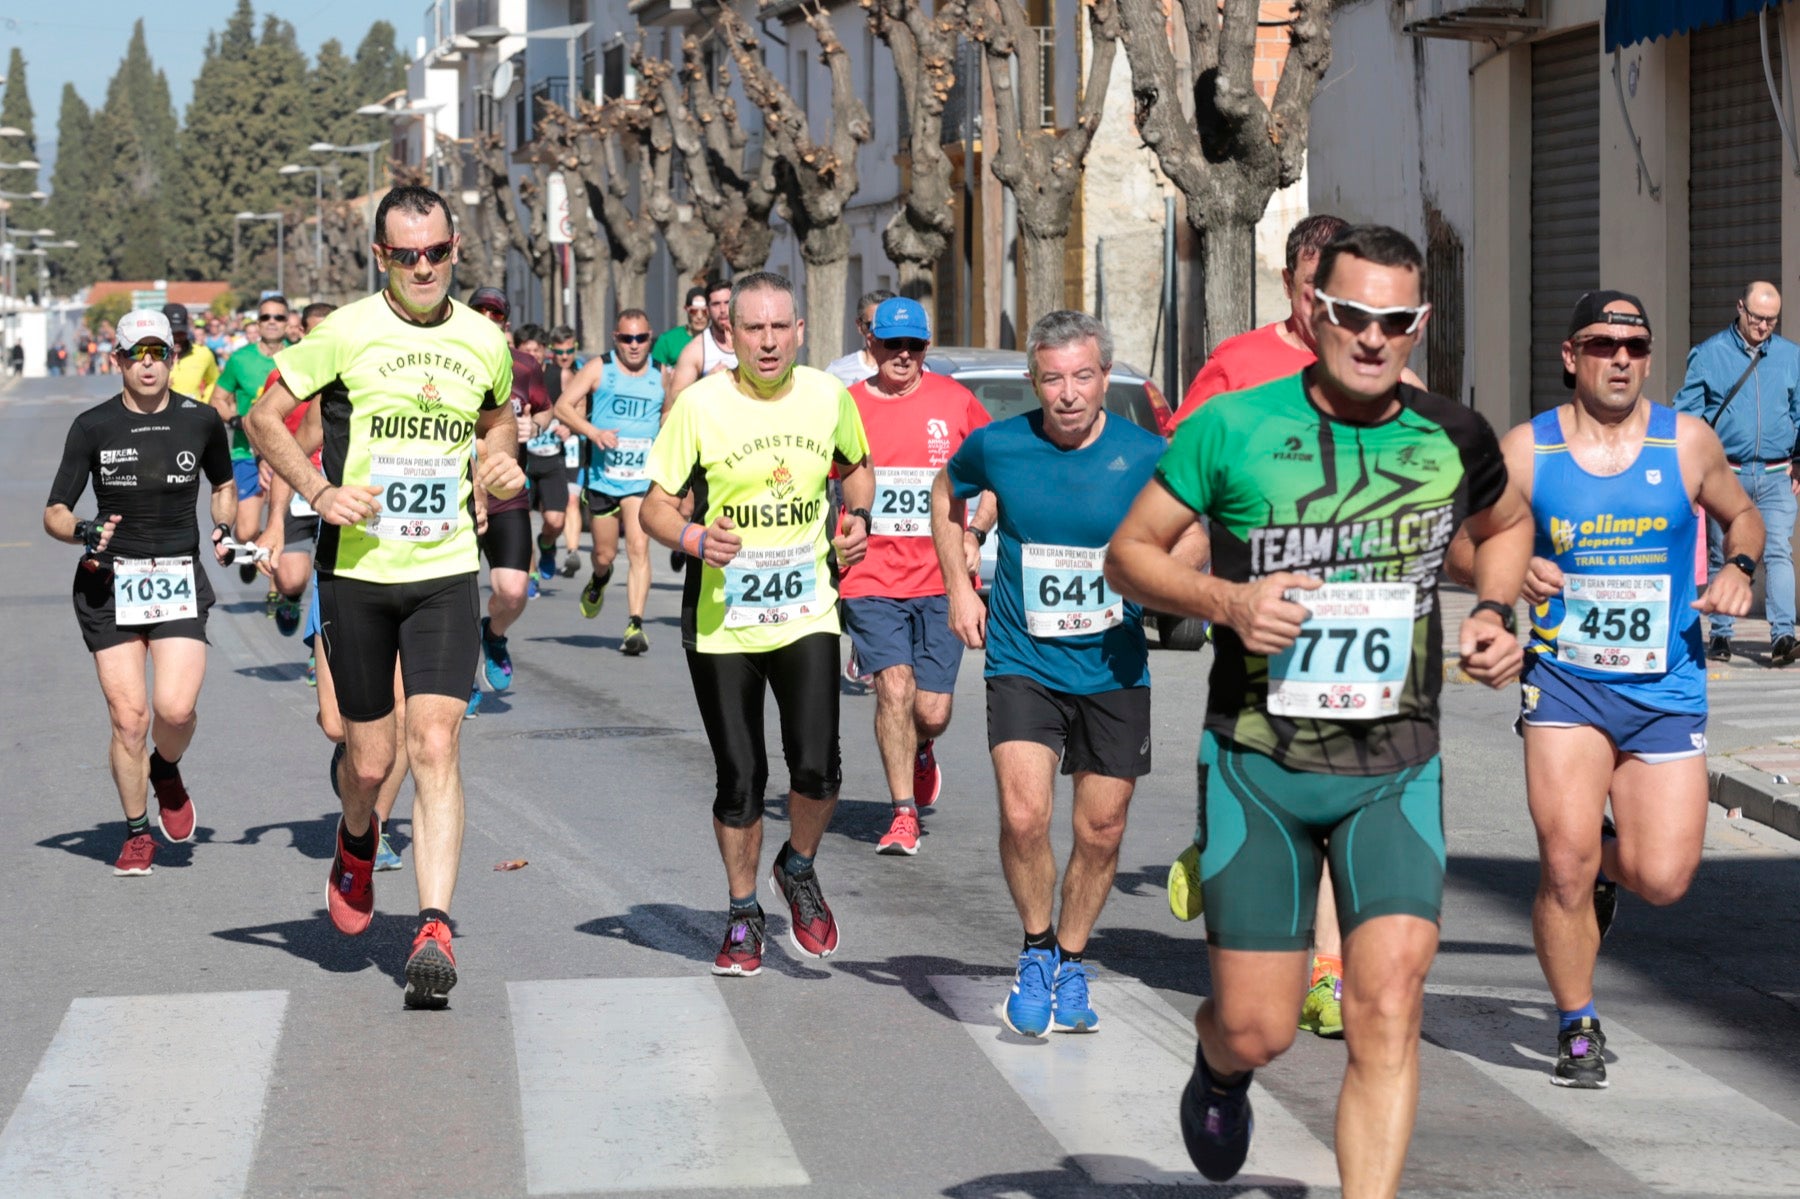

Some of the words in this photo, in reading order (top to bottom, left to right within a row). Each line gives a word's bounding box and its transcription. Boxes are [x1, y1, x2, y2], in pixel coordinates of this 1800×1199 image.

[379, 353, 476, 385] FLORISTERIA
[370, 413, 474, 443] RUISEÑOR
[396, 457, 413, 466] GRAN
[414, 458, 433, 467] PREMIO
[434, 458, 440, 467] DE
[441, 458, 457, 466] FONDO
[613, 451, 645, 467] 824
[724, 434, 828, 469] FLORISTERIA
[386, 481, 446, 514] 625
[881, 489, 931, 514] 293
[1580, 513, 1668, 537] olimpo
[747, 550, 764, 559] GRAN
[764, 550, 786, 559] PREMIO
[787, 548, 794, 557] DE
[1046, 548, 1064, 558] GRAN
[1064, 550, 1088, 559] PREMIO
[1088, 551, 1096, 560] DE
[1248, 526, 1334, 574] TEAM
[1578, 537, 1634, 549] deportes
[1575, 555, 1606, 567] TRAIL
[1607, 554, 1616, 566] &
[1618, 552, 1668, 565] RUNNING
[121, 577, 191, 603] 1034
[741, 570, 803, 602] 246
[1039, 574, 1105, 607] 641
[1303, 590, 1327, 601] GRAN
[1330, 589, 1363, 600] PREMIO
[1365, 589, 1376, 600] DE
[1587, 579, 1605, 588] GRAN
[1607, 579, 1633, 589] PREMIO
[1634, 580, 1643, 589] DE
[1578, 606, 1651, 642] 458
[1296, 627, 1391, 674] 776
